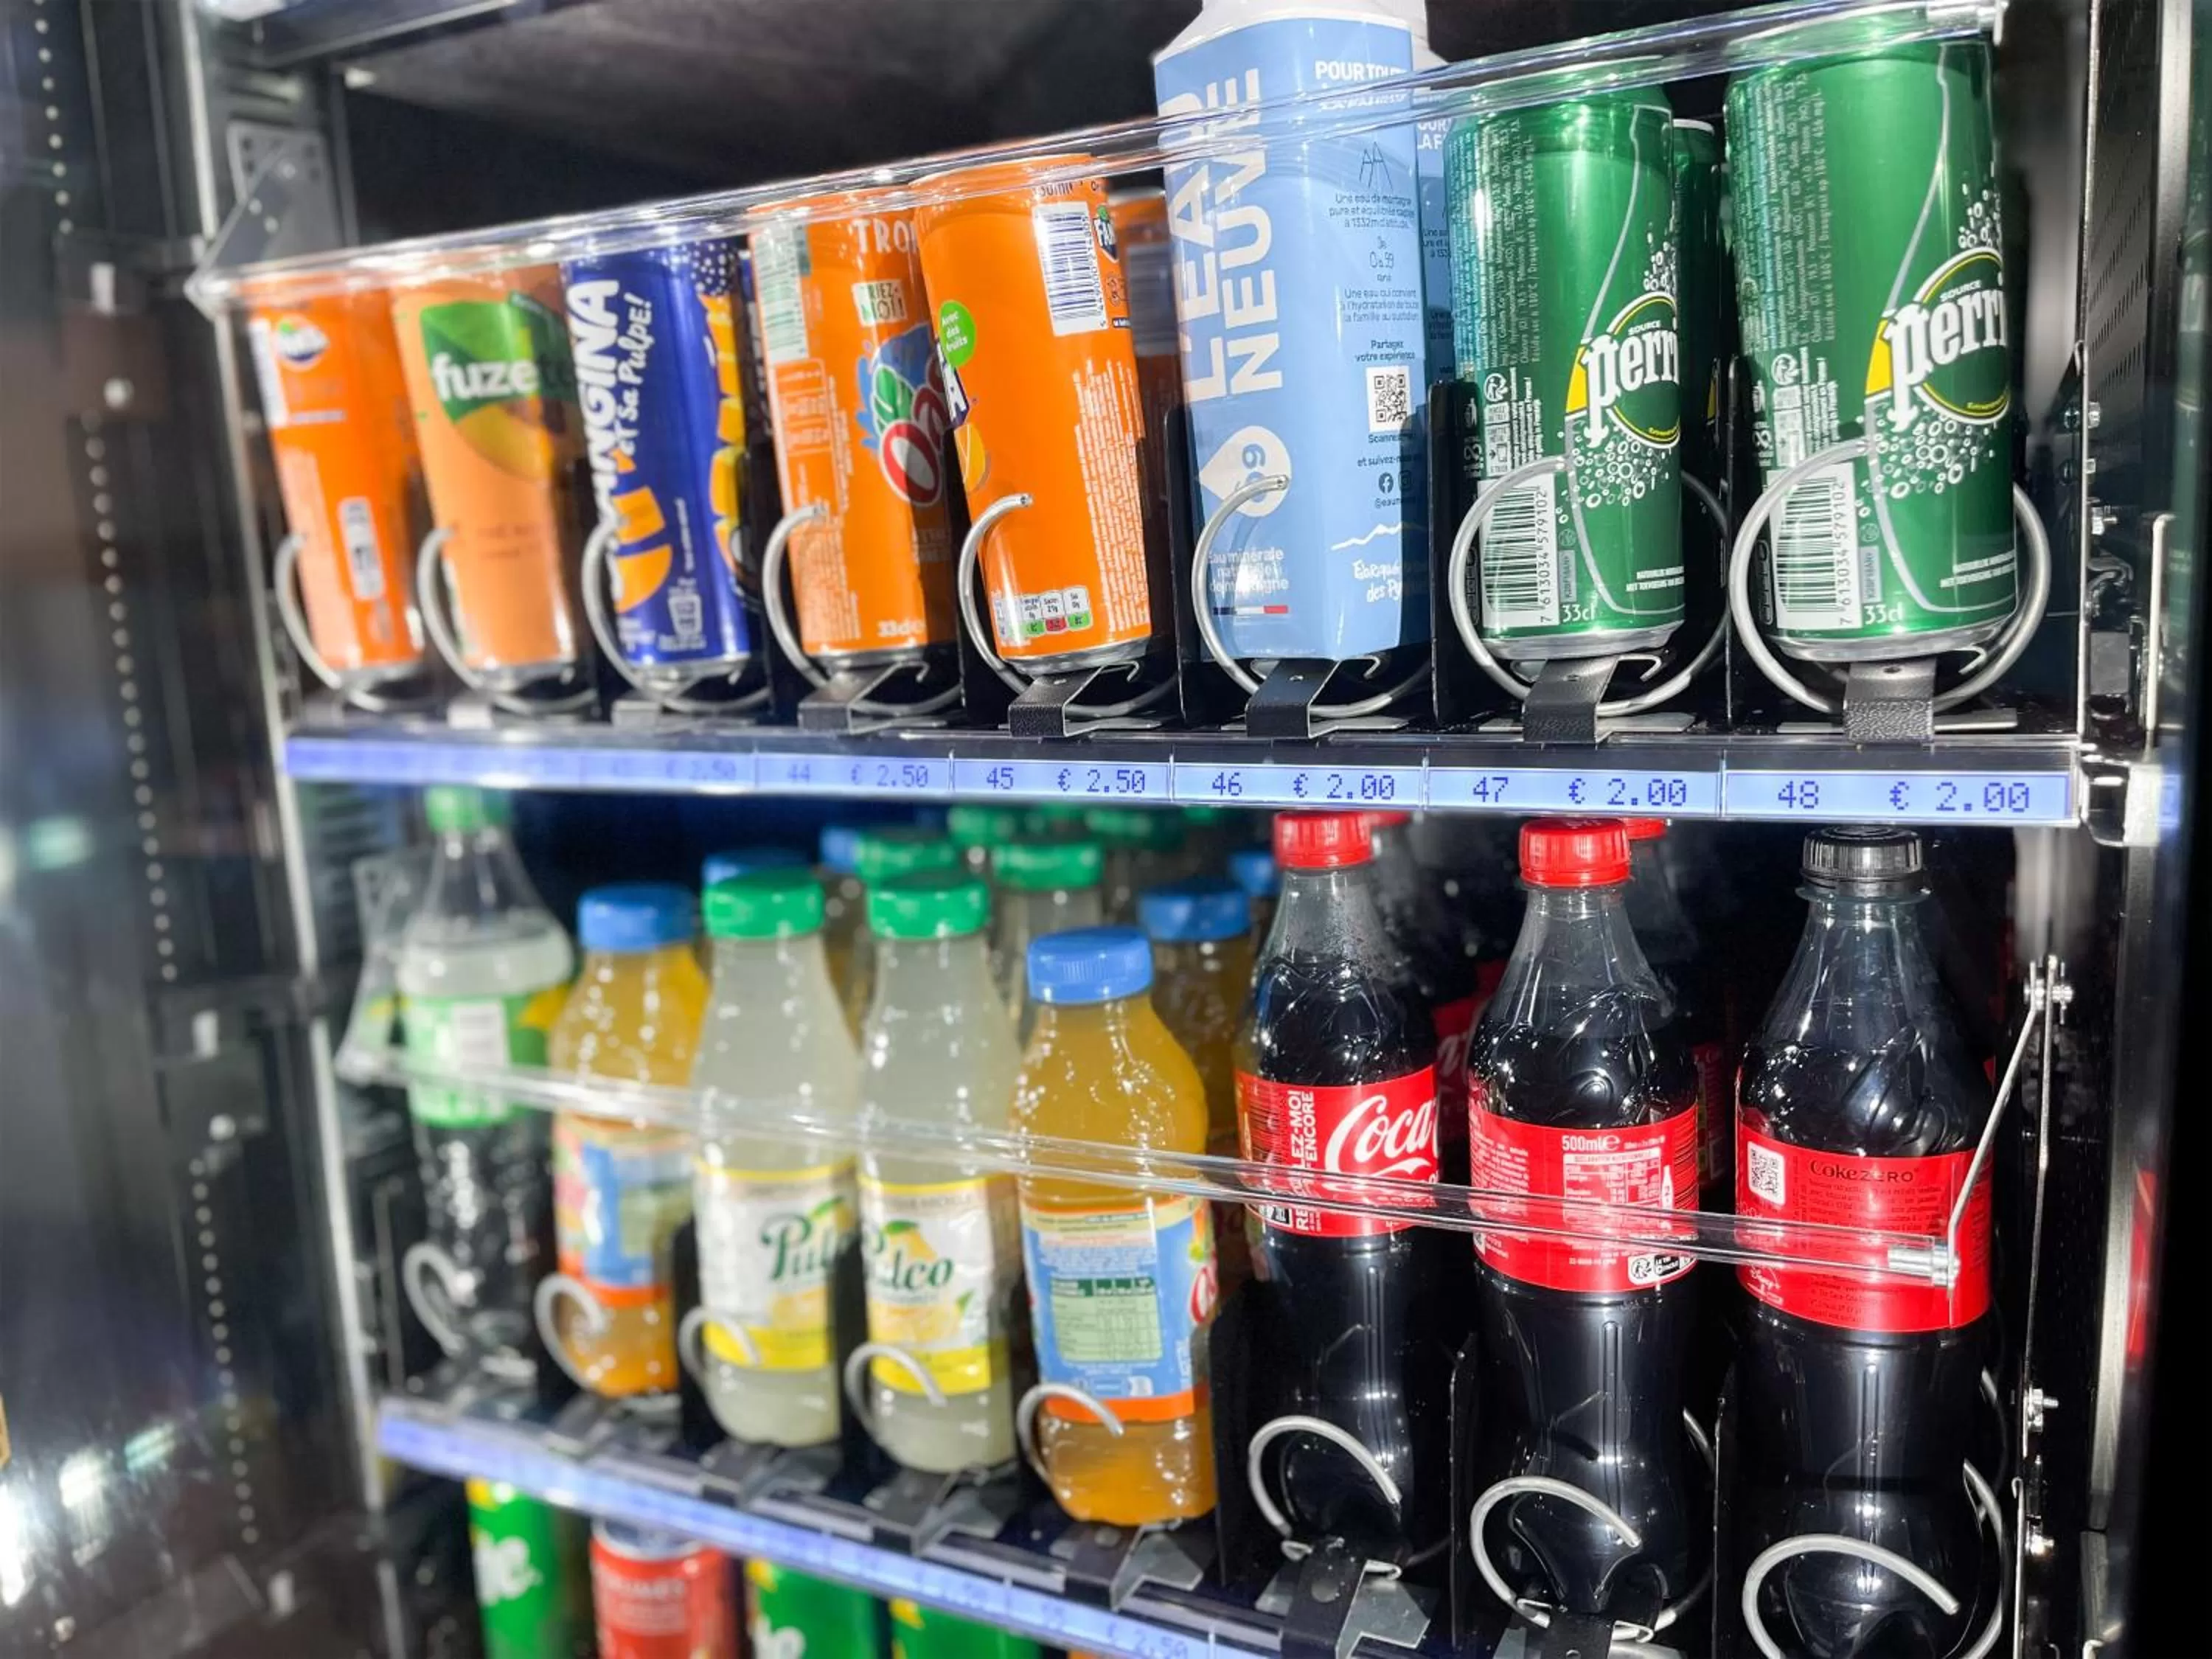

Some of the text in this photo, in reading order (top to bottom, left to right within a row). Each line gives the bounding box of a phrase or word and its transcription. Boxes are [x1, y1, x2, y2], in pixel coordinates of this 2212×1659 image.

[1315, 60, 1360, 81] POUR
[1208, 68, 1284, 395] NEUVE
[432, 352, 538, 403] fuze
[1536, 490, 1549, 544] 579102
[1832, 481, 1851, 625] 7 613034 579102
[1538, 551, 1551, 606] 613034
[1562, 603, 1596, 622] 33cl
[1864, 600, 1904, 625] 33cl
[787, 763, 811, 784] 44
[876, 765, 929, 788] 2.50
[986, 767, 1147, 794] 45 € 2.50
[1211, 771, 1396, 800] 46 € 2.00
[1472, 776, 1688, 807] 47 € 2.00
[1778, 780, 2031, 812] 48 € 2.00
[1300, 1091, 1318, 1161] ENCORE
